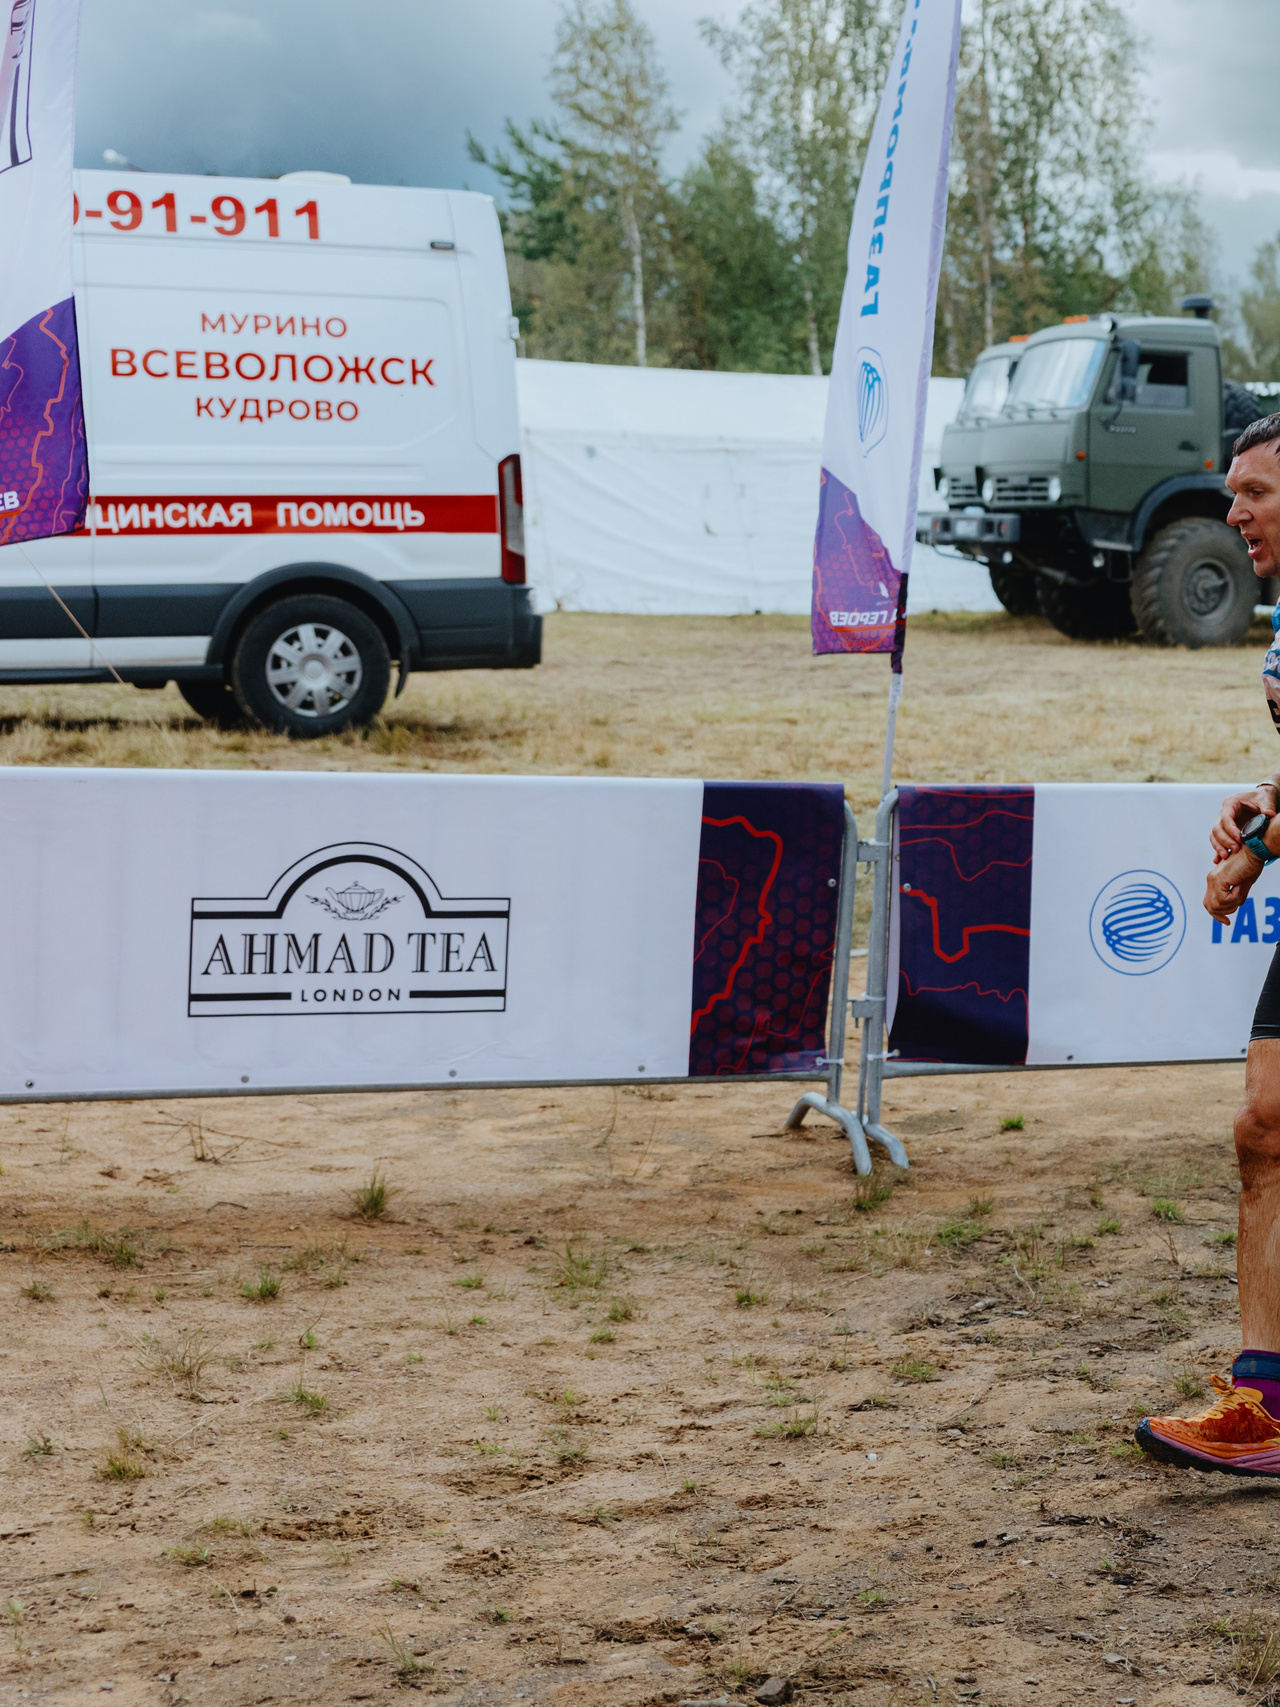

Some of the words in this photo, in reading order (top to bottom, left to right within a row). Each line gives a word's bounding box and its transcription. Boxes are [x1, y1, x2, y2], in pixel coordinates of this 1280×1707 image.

[201, 312, 347, 338] МУРИНО
[110, 348, 434, 386] ВСЕВОЛОЖСК
[196, 397, 359, 422] КУДРОВО
[276, 502, 426, 531] ПОМОЩЬ
[201, 932, 394, 975] AHMAD
[407, 931, 498, 973] TEA
[301, 988, 401, 1002] LONDON
